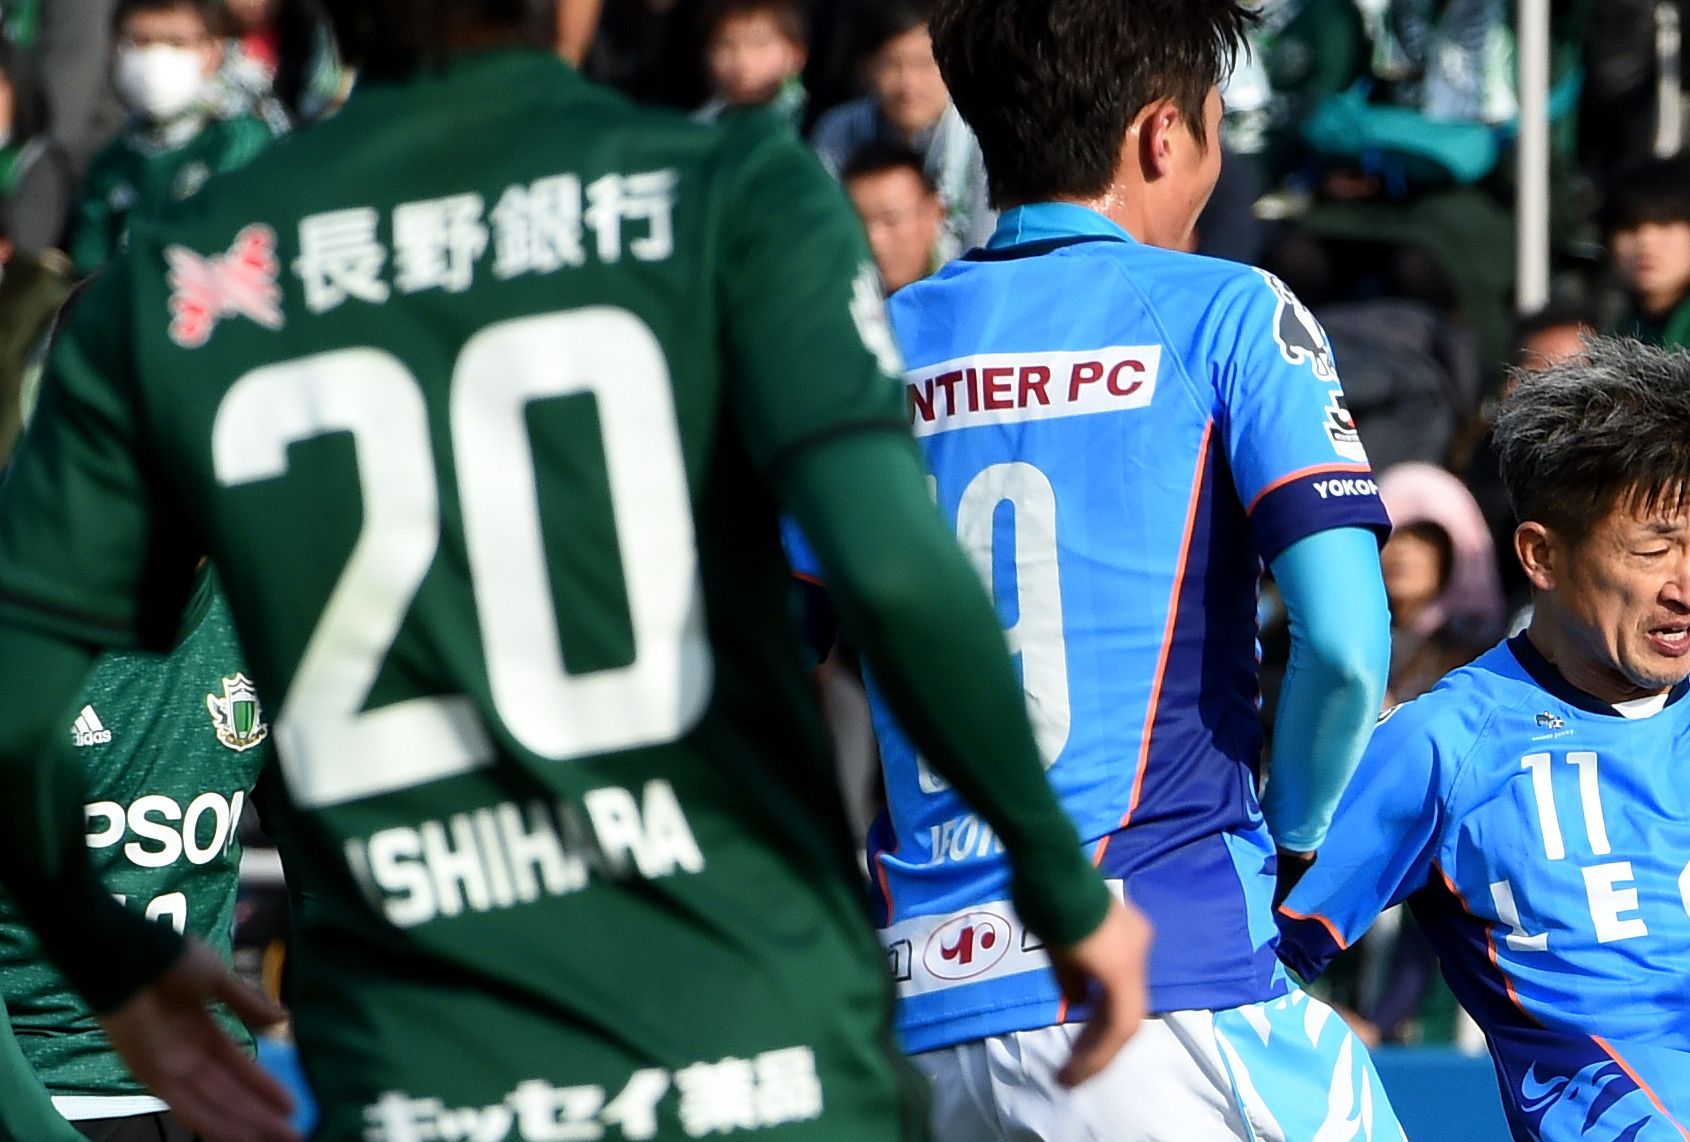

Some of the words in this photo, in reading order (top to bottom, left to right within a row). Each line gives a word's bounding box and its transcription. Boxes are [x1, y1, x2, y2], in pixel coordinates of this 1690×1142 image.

[293, 167, 679, 313] 長野銀行
[1068, 359, 1146, 403] PC
[211, 304, 714, 811] 20
[72, 729, 112, 747] didas
[1520, 751, 1612, 861] 11
